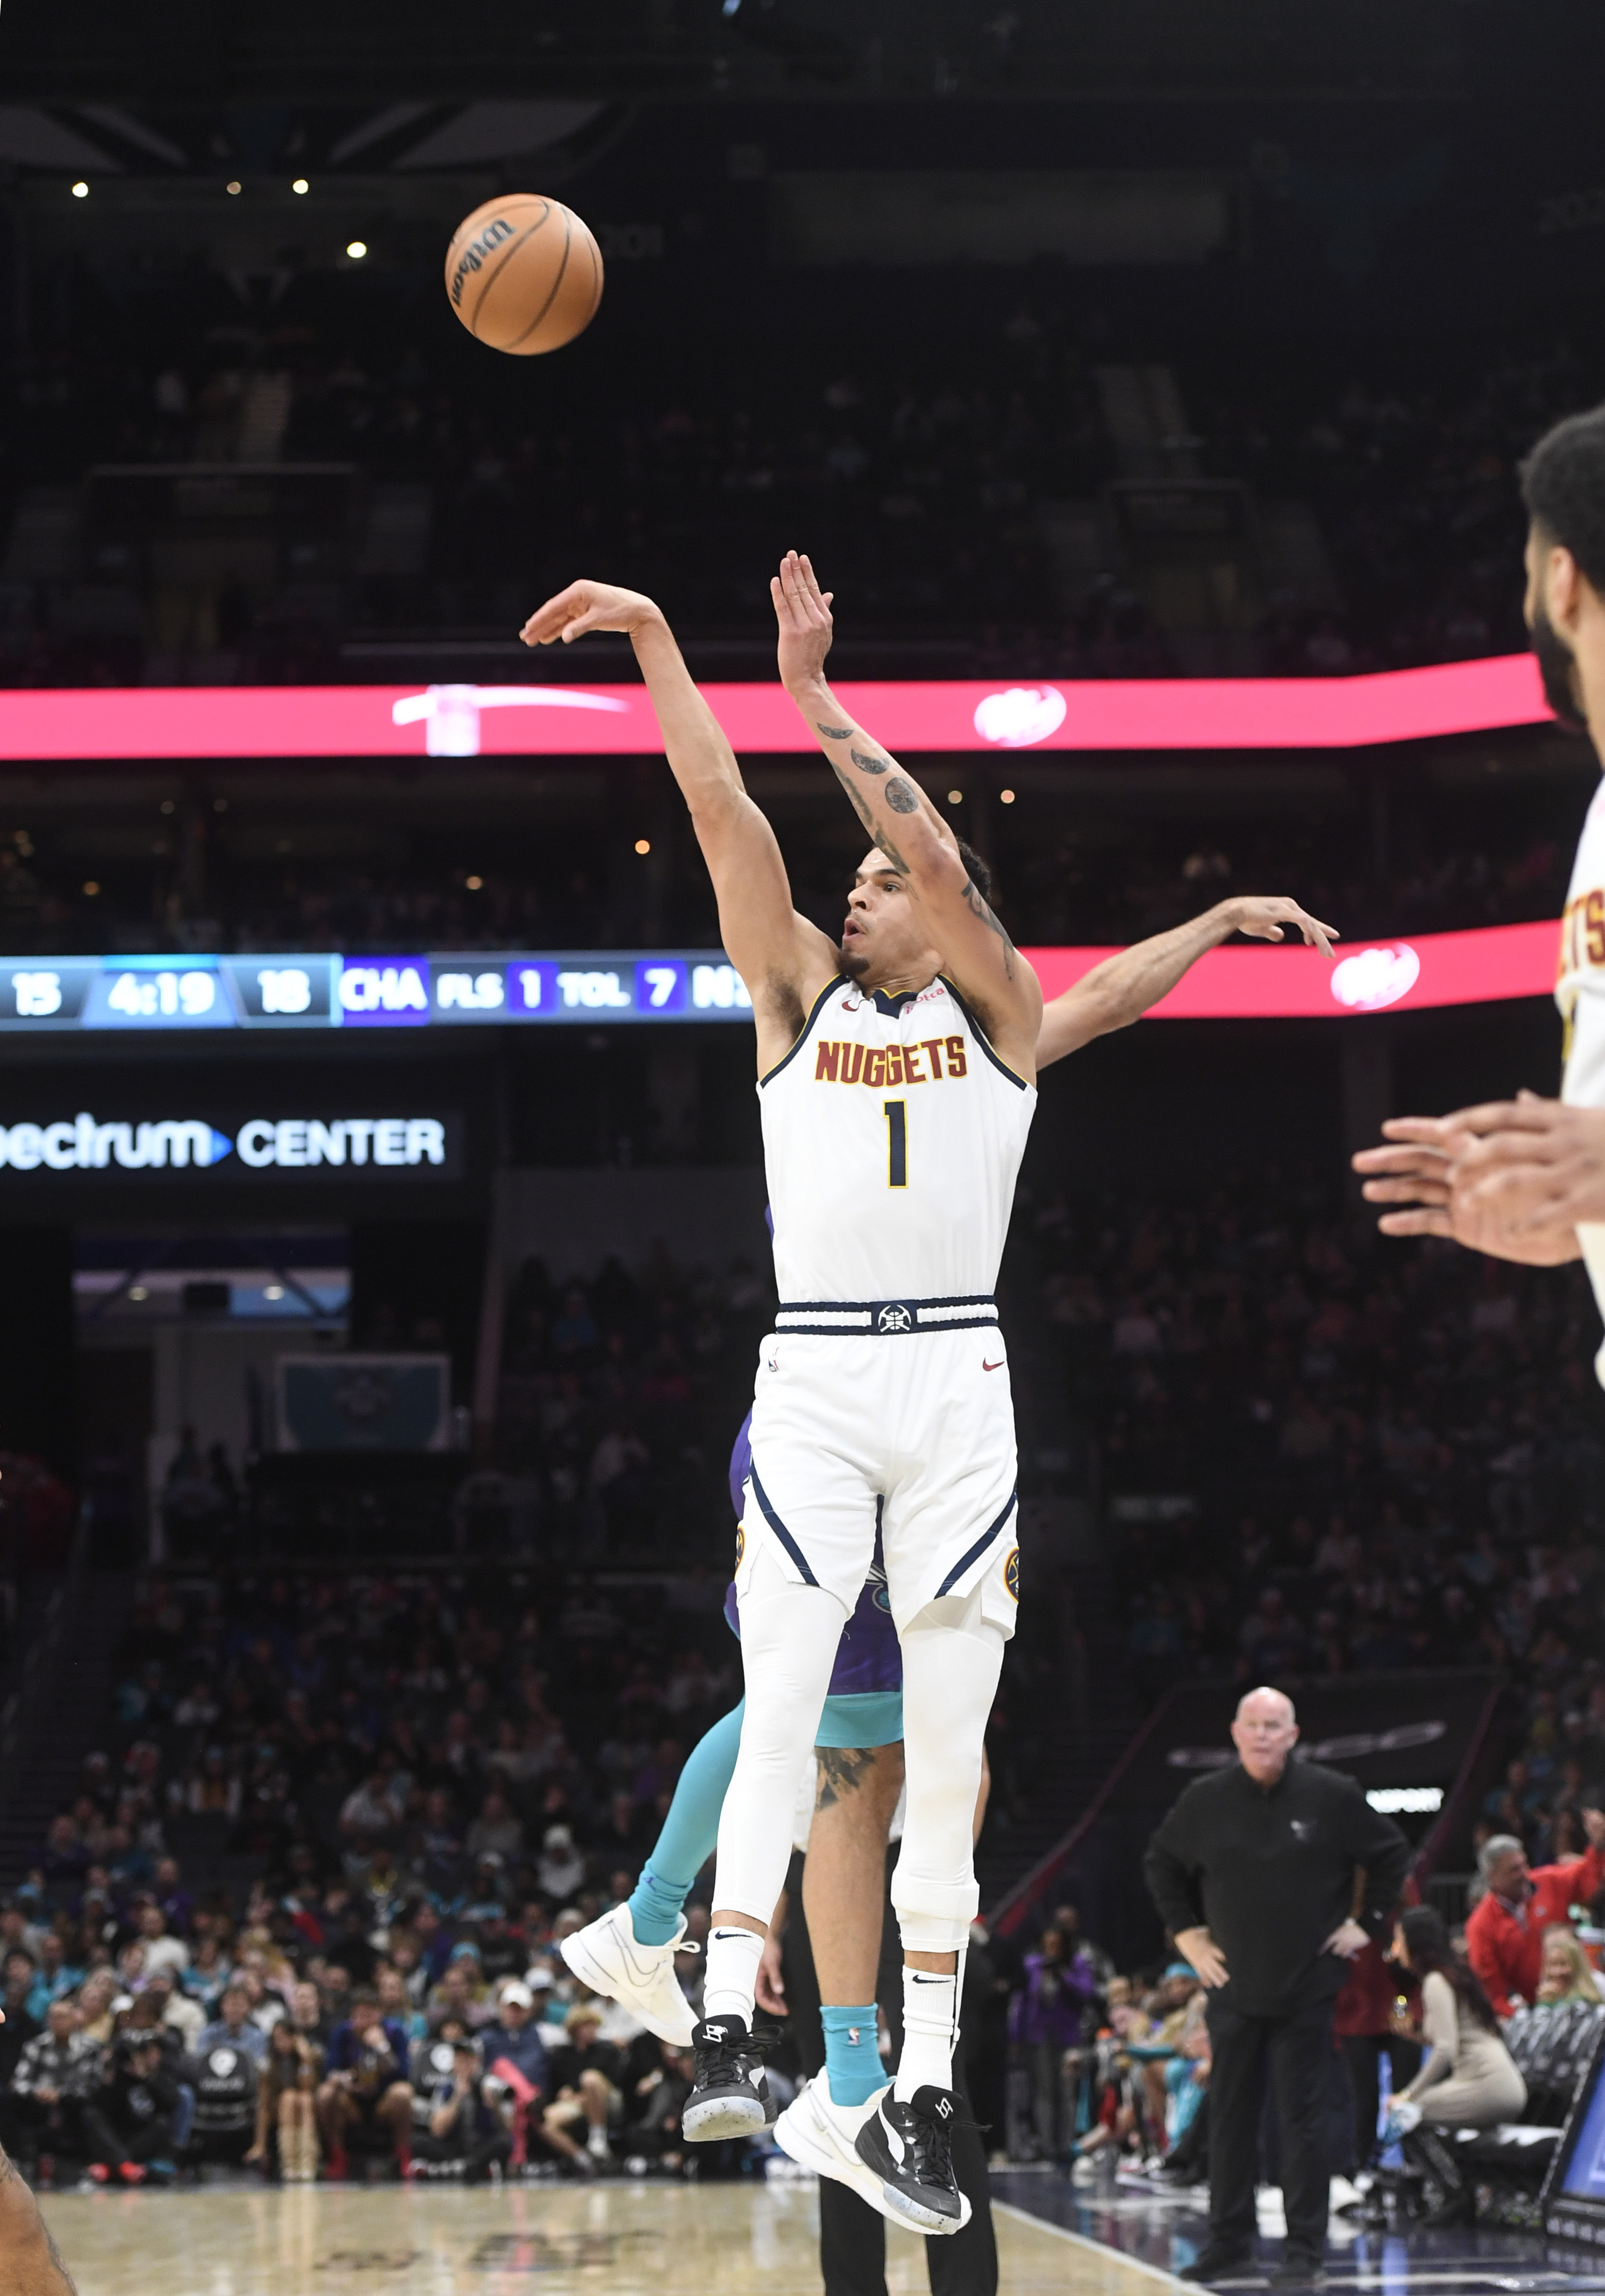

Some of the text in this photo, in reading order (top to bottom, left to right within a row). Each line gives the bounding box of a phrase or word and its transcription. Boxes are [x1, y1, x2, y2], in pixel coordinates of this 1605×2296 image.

[452, 219, 518, 308] Wilson
[12, 969, 311, 1015] 15 4:19 18
[337, 967, 428, 1012] CHA
[436, 973, 503, 1008] FLS
[518, 970, 541, 1008] 1
[557, 972, 631, 1007] TOL
[644, 968, 677, 1007] 7
[906, 987, 945, 1014] iotta
[814, 1035, 968, 1089] NUGGETS
[0, 1112, 445, 1170] ectrum CENTER
[883, 1098, 908, 1189] 1
